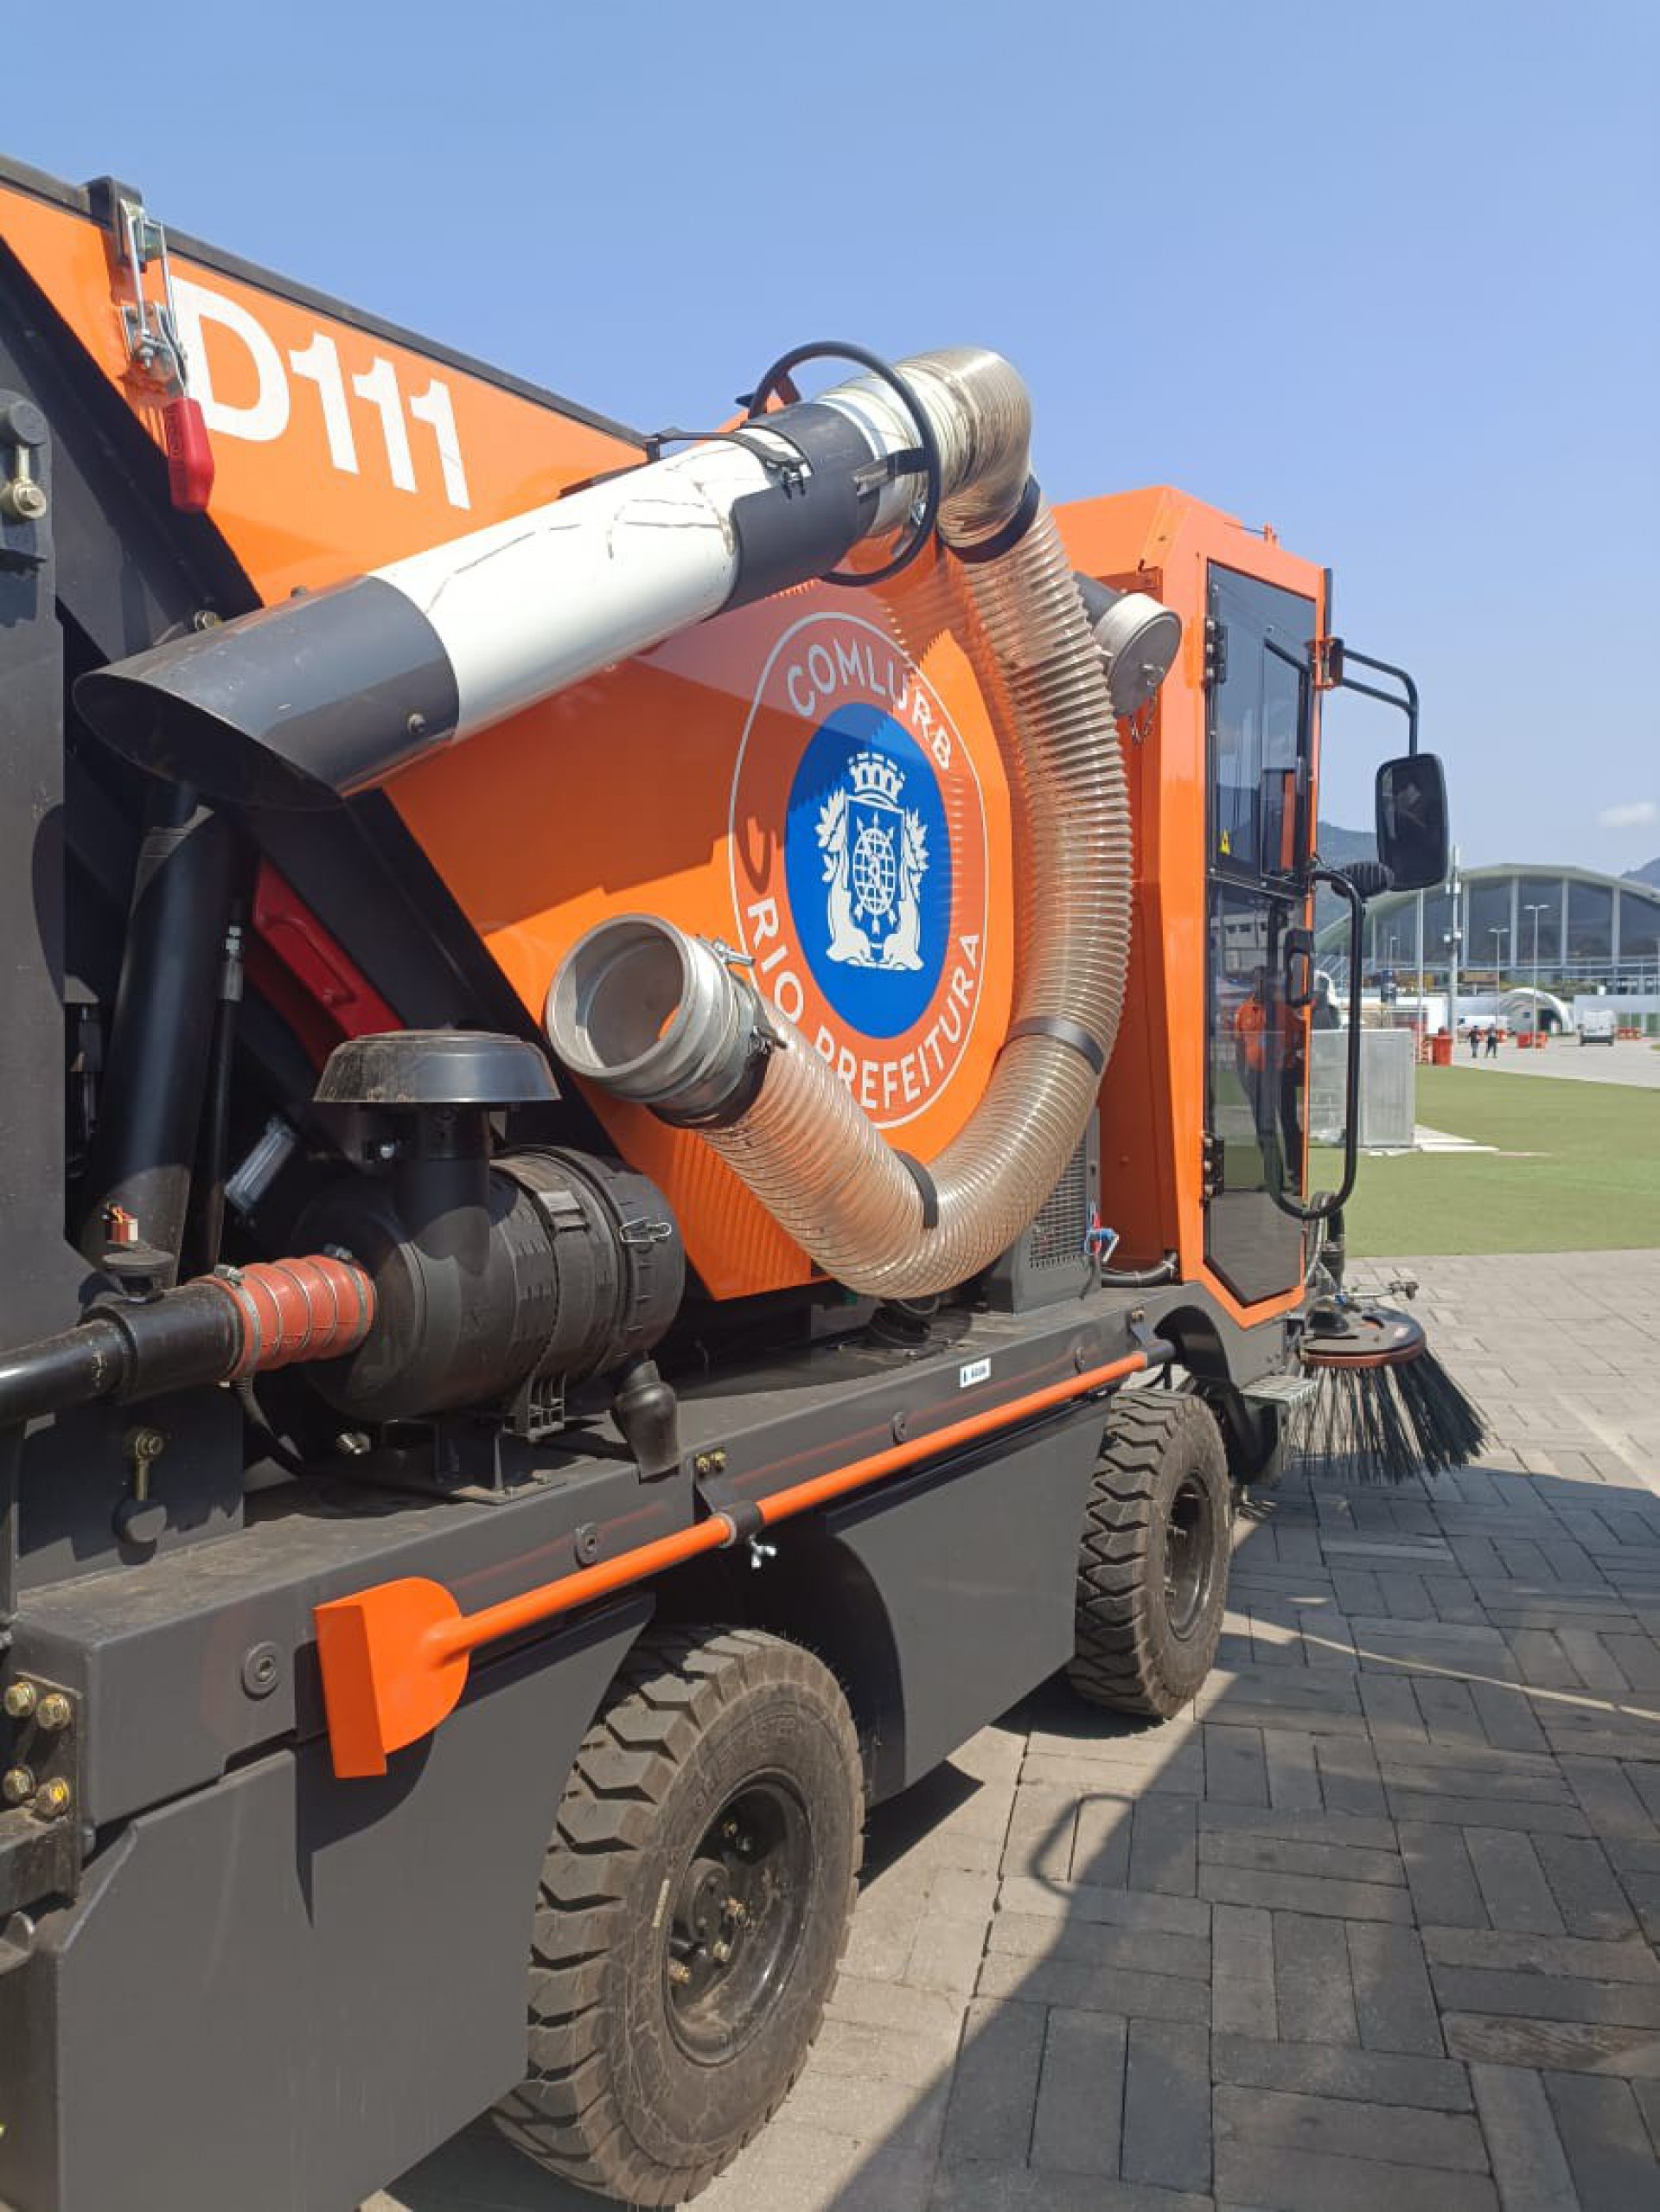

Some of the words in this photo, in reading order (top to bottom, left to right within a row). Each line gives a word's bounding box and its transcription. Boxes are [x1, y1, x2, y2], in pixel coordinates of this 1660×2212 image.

[170, 275, 470, 509] D111
[788, 637, 951, 770] COMLURB
[748, 898, 804, 1024] RIO
[815, 935, 979, 1109] PREFEITURA
